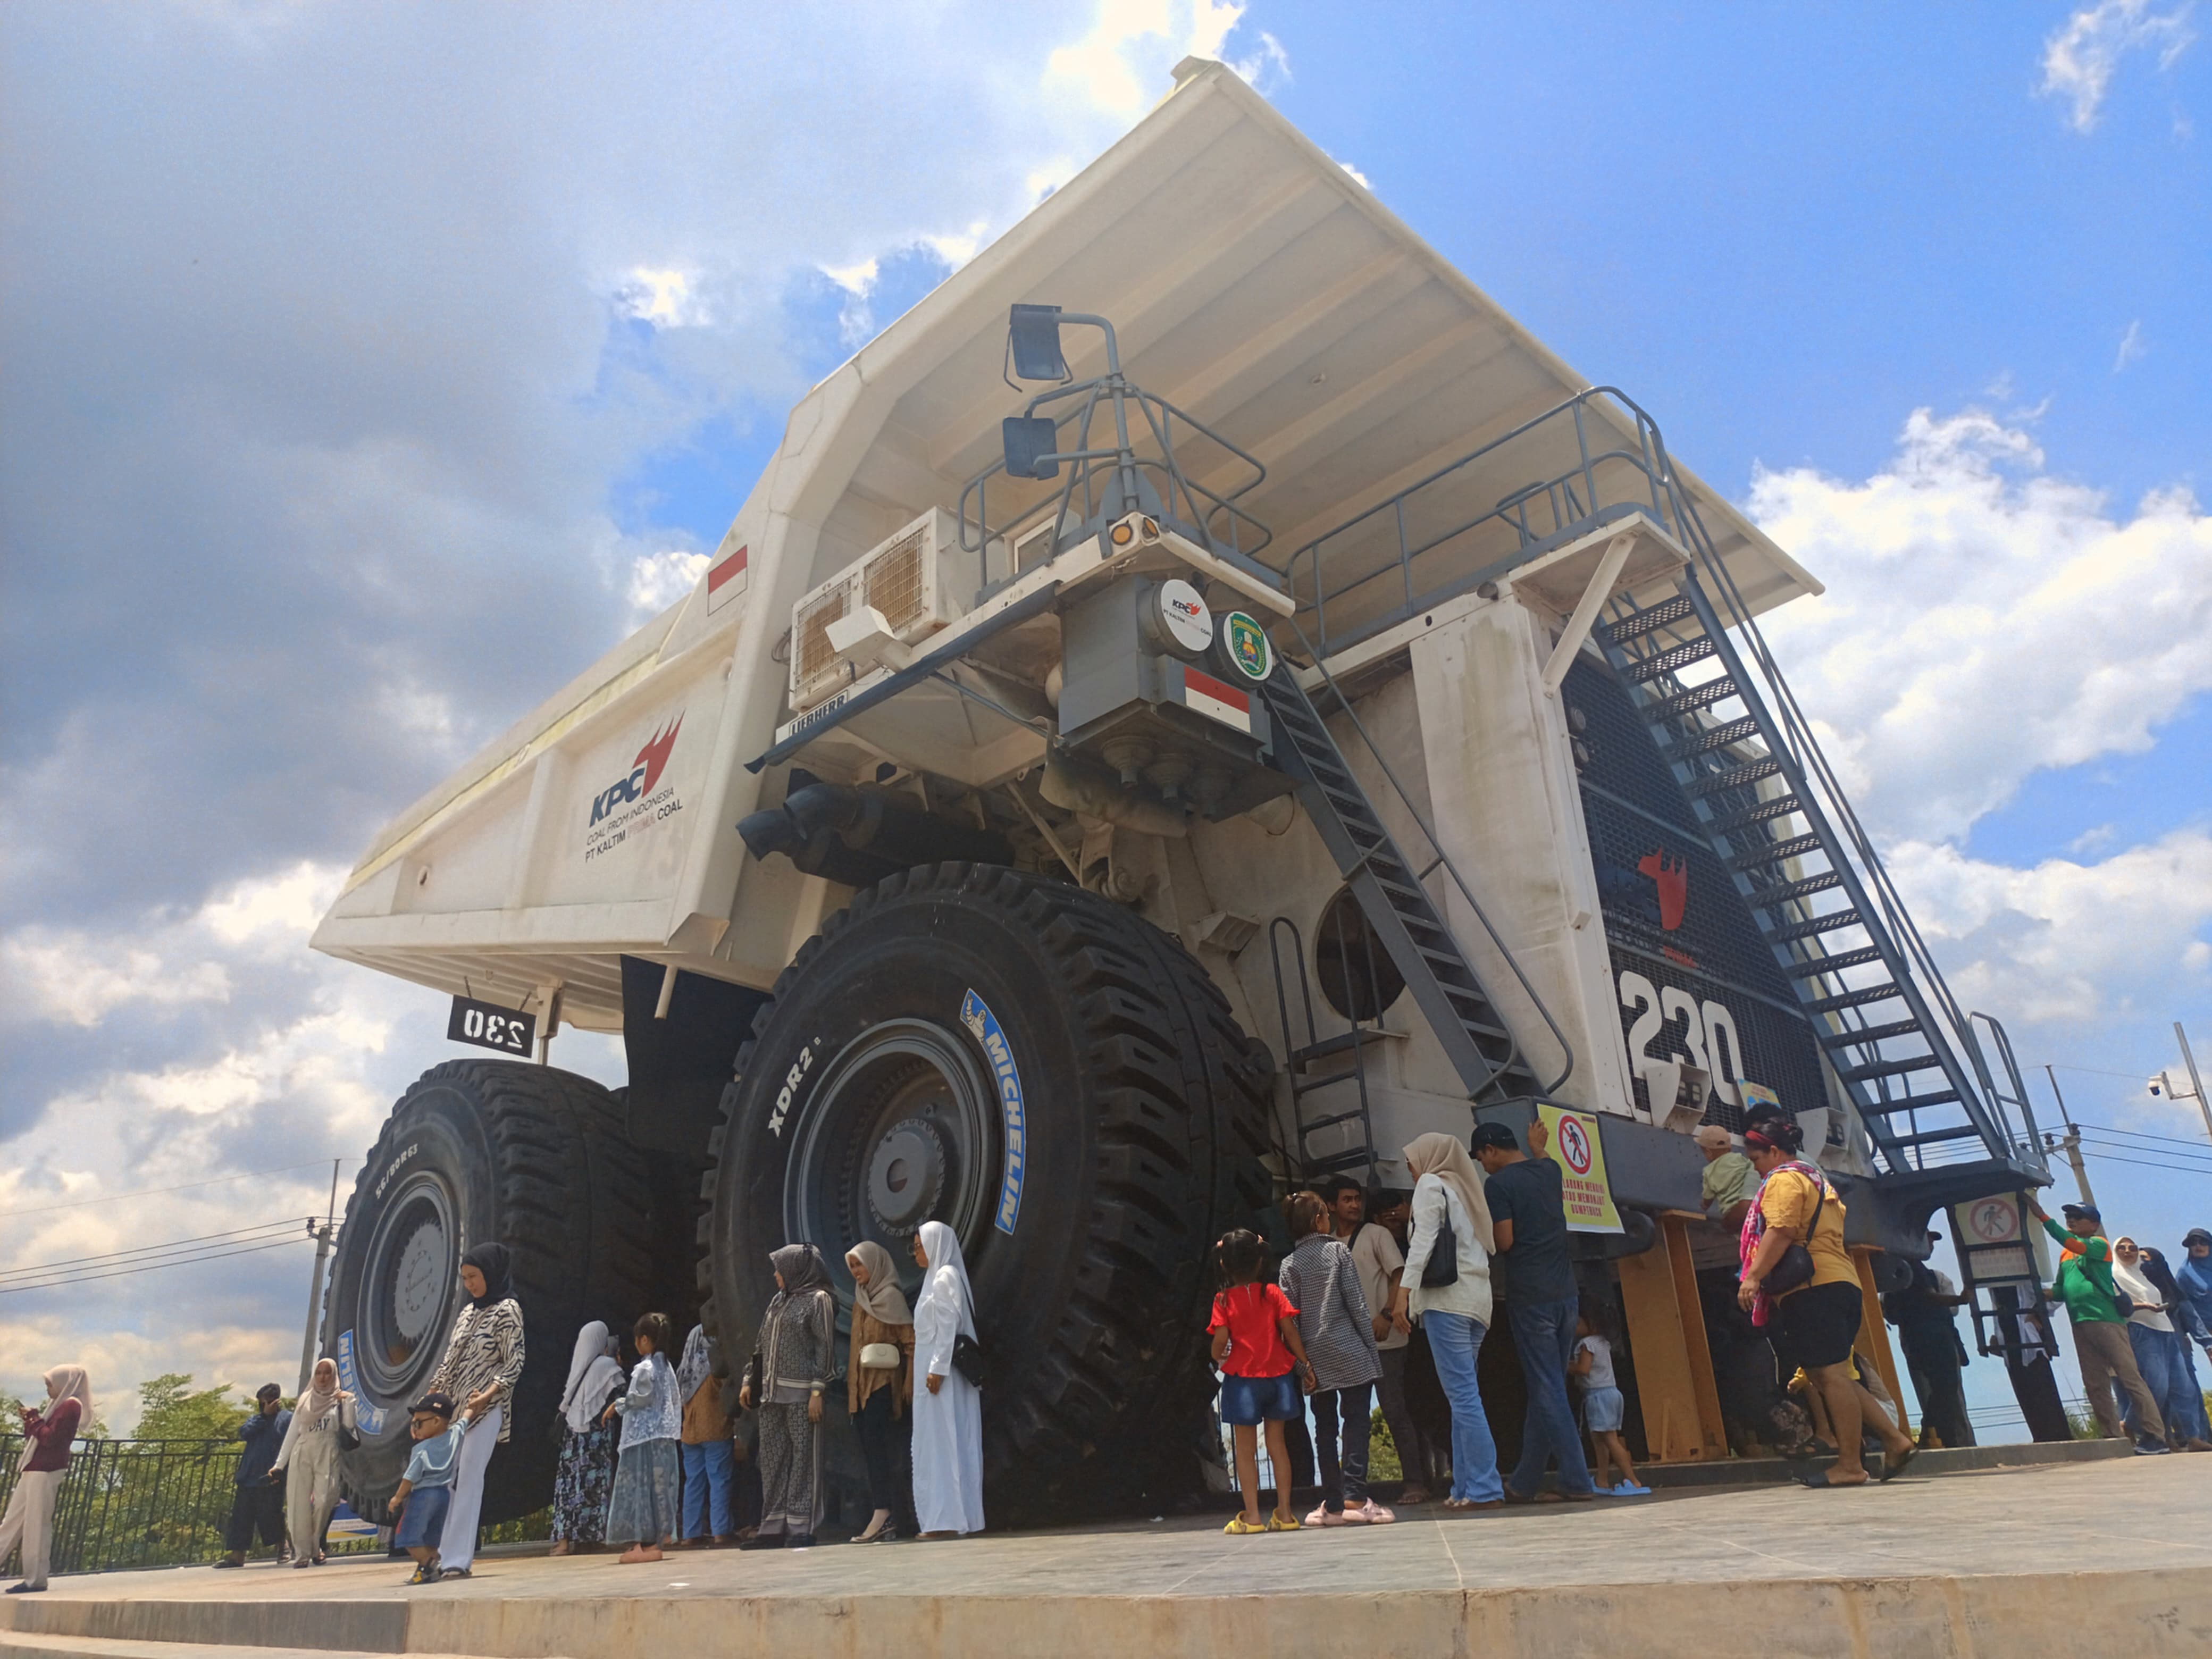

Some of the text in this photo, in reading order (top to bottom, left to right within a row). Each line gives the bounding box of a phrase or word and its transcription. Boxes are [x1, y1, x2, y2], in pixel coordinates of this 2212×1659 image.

[1172, 599, 1191, 614] KPC
[792, 695, 844, 735] LIEBHERR
[587, 786, 674, 845] COAL FROM INDONESIA
[589, 767, 645, 828] KPC
[585, 848, 596, 863] PT
[597, 830, 626, 856] KALTIM
[657, 799, 683, 820] COAL
[1620, 970, 1745, 1107] 230
[768, 1046, 813, 1137] XDR2
[986, 1032, 1021, 1231] MICHELIN
[1562, 1178, 1583, 1191] LARANG
